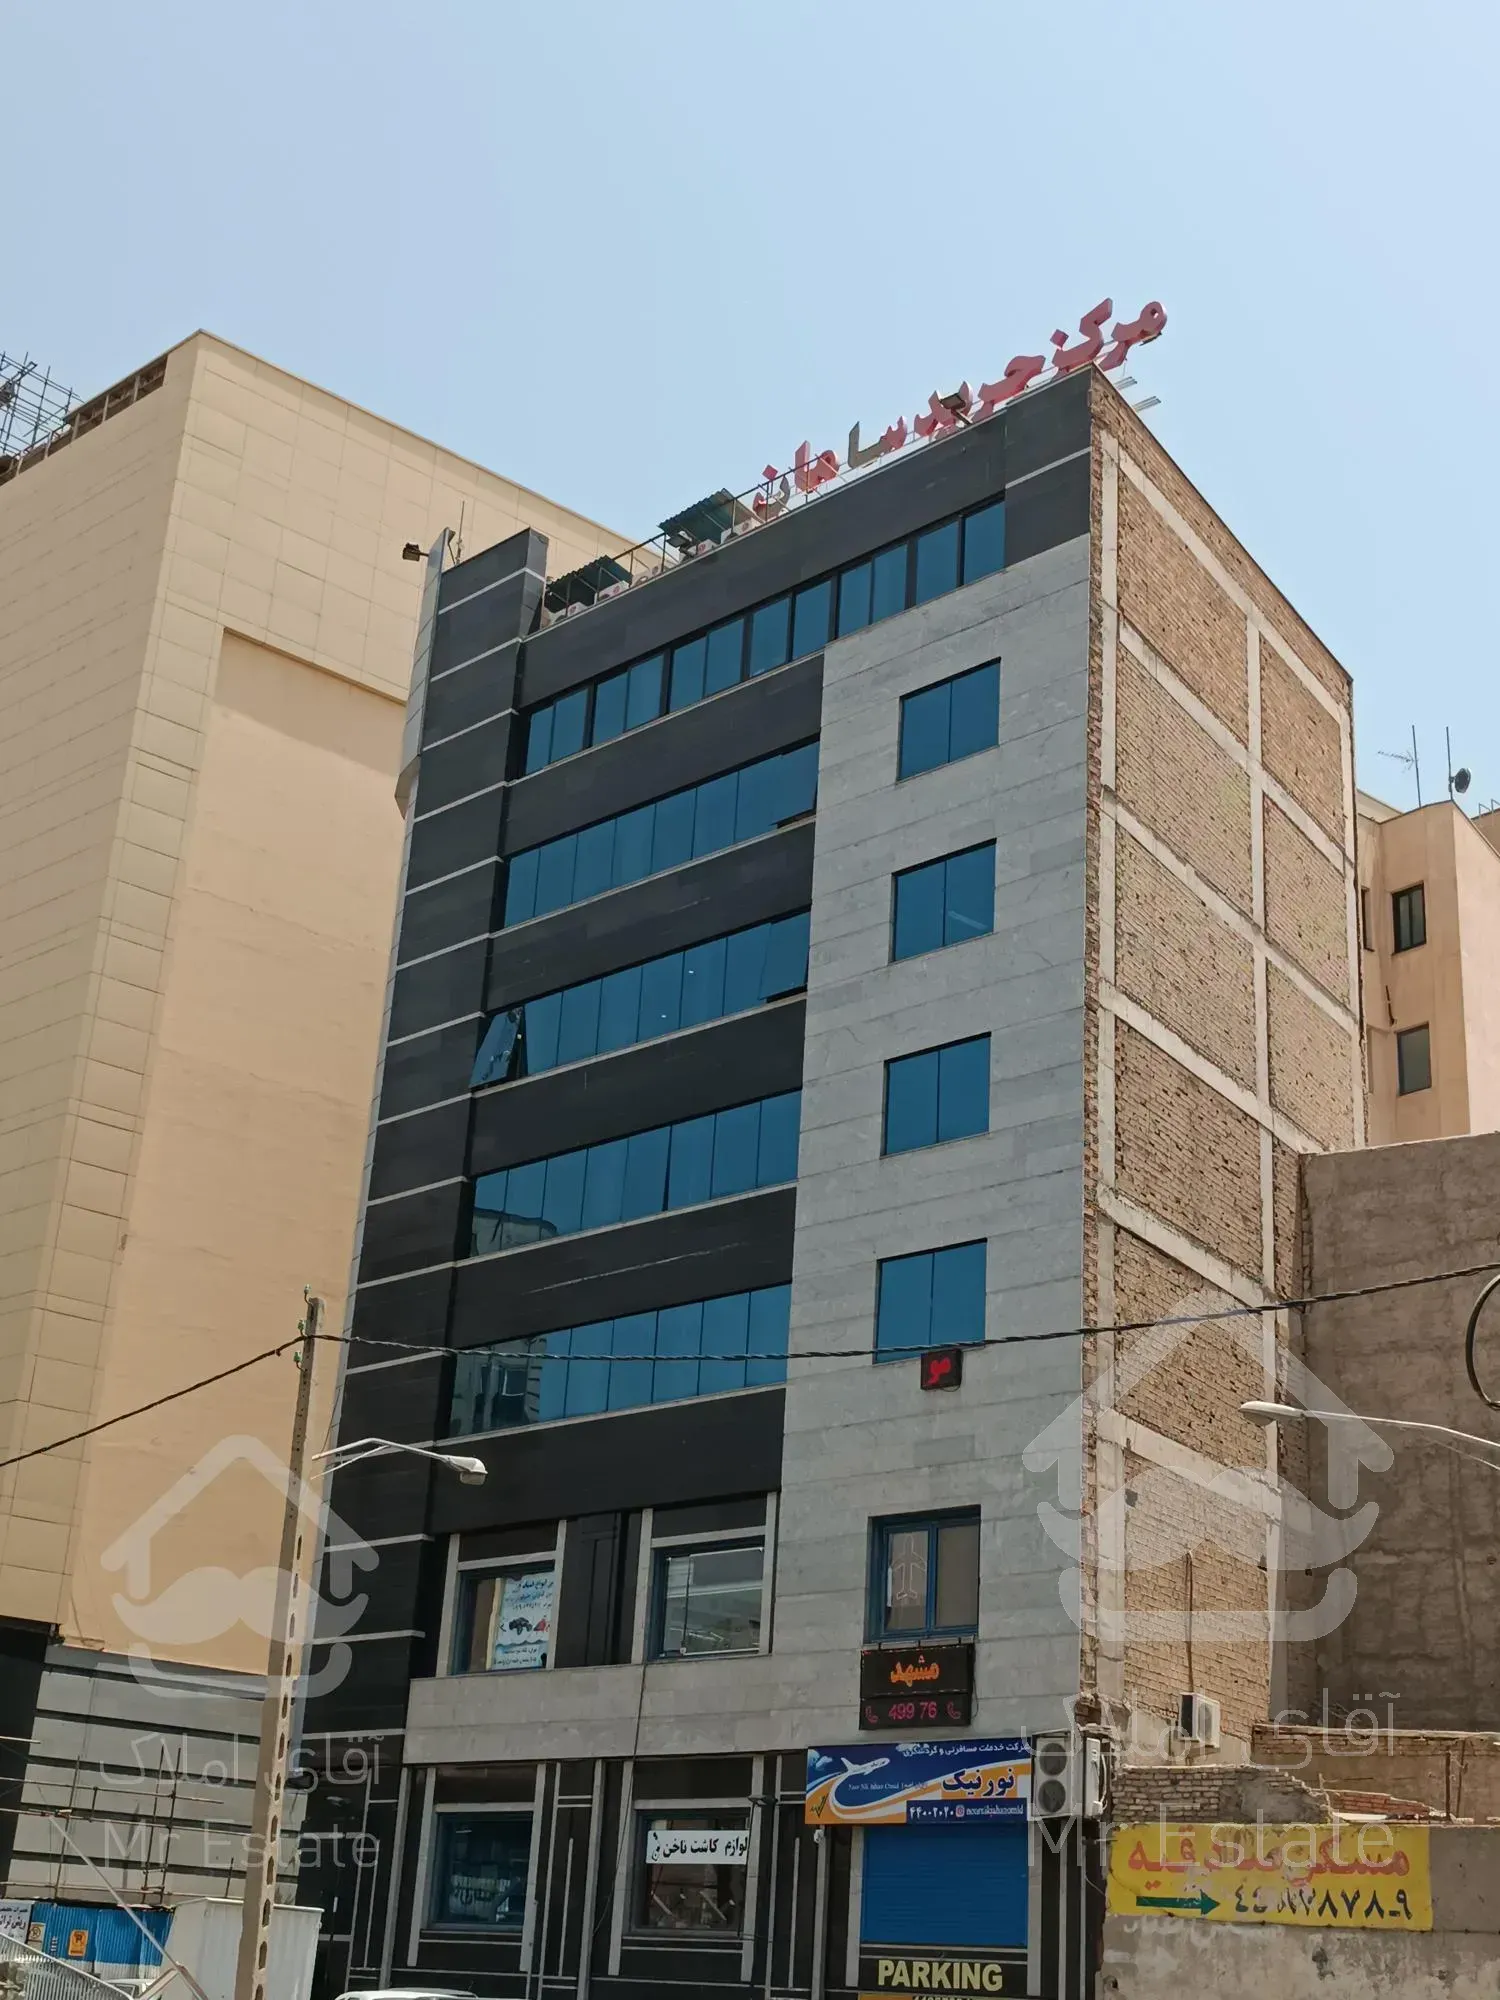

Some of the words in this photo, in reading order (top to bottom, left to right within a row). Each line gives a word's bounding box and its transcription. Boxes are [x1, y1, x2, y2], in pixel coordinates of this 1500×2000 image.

[1048, 297, 1168, 374] مرکز
[889, 1654, 940, 1688] مشهد
[888, 1702, 915, 1720] 499
[919, 1701, 938, 1719] 76
[662, 1837, 687, 1858] ناخن
[690, 1837, 719, 1854] کاشت
[724, 1836, 749, 1857] لوازم
[877, 1959, 1004, 1992] PARKING
